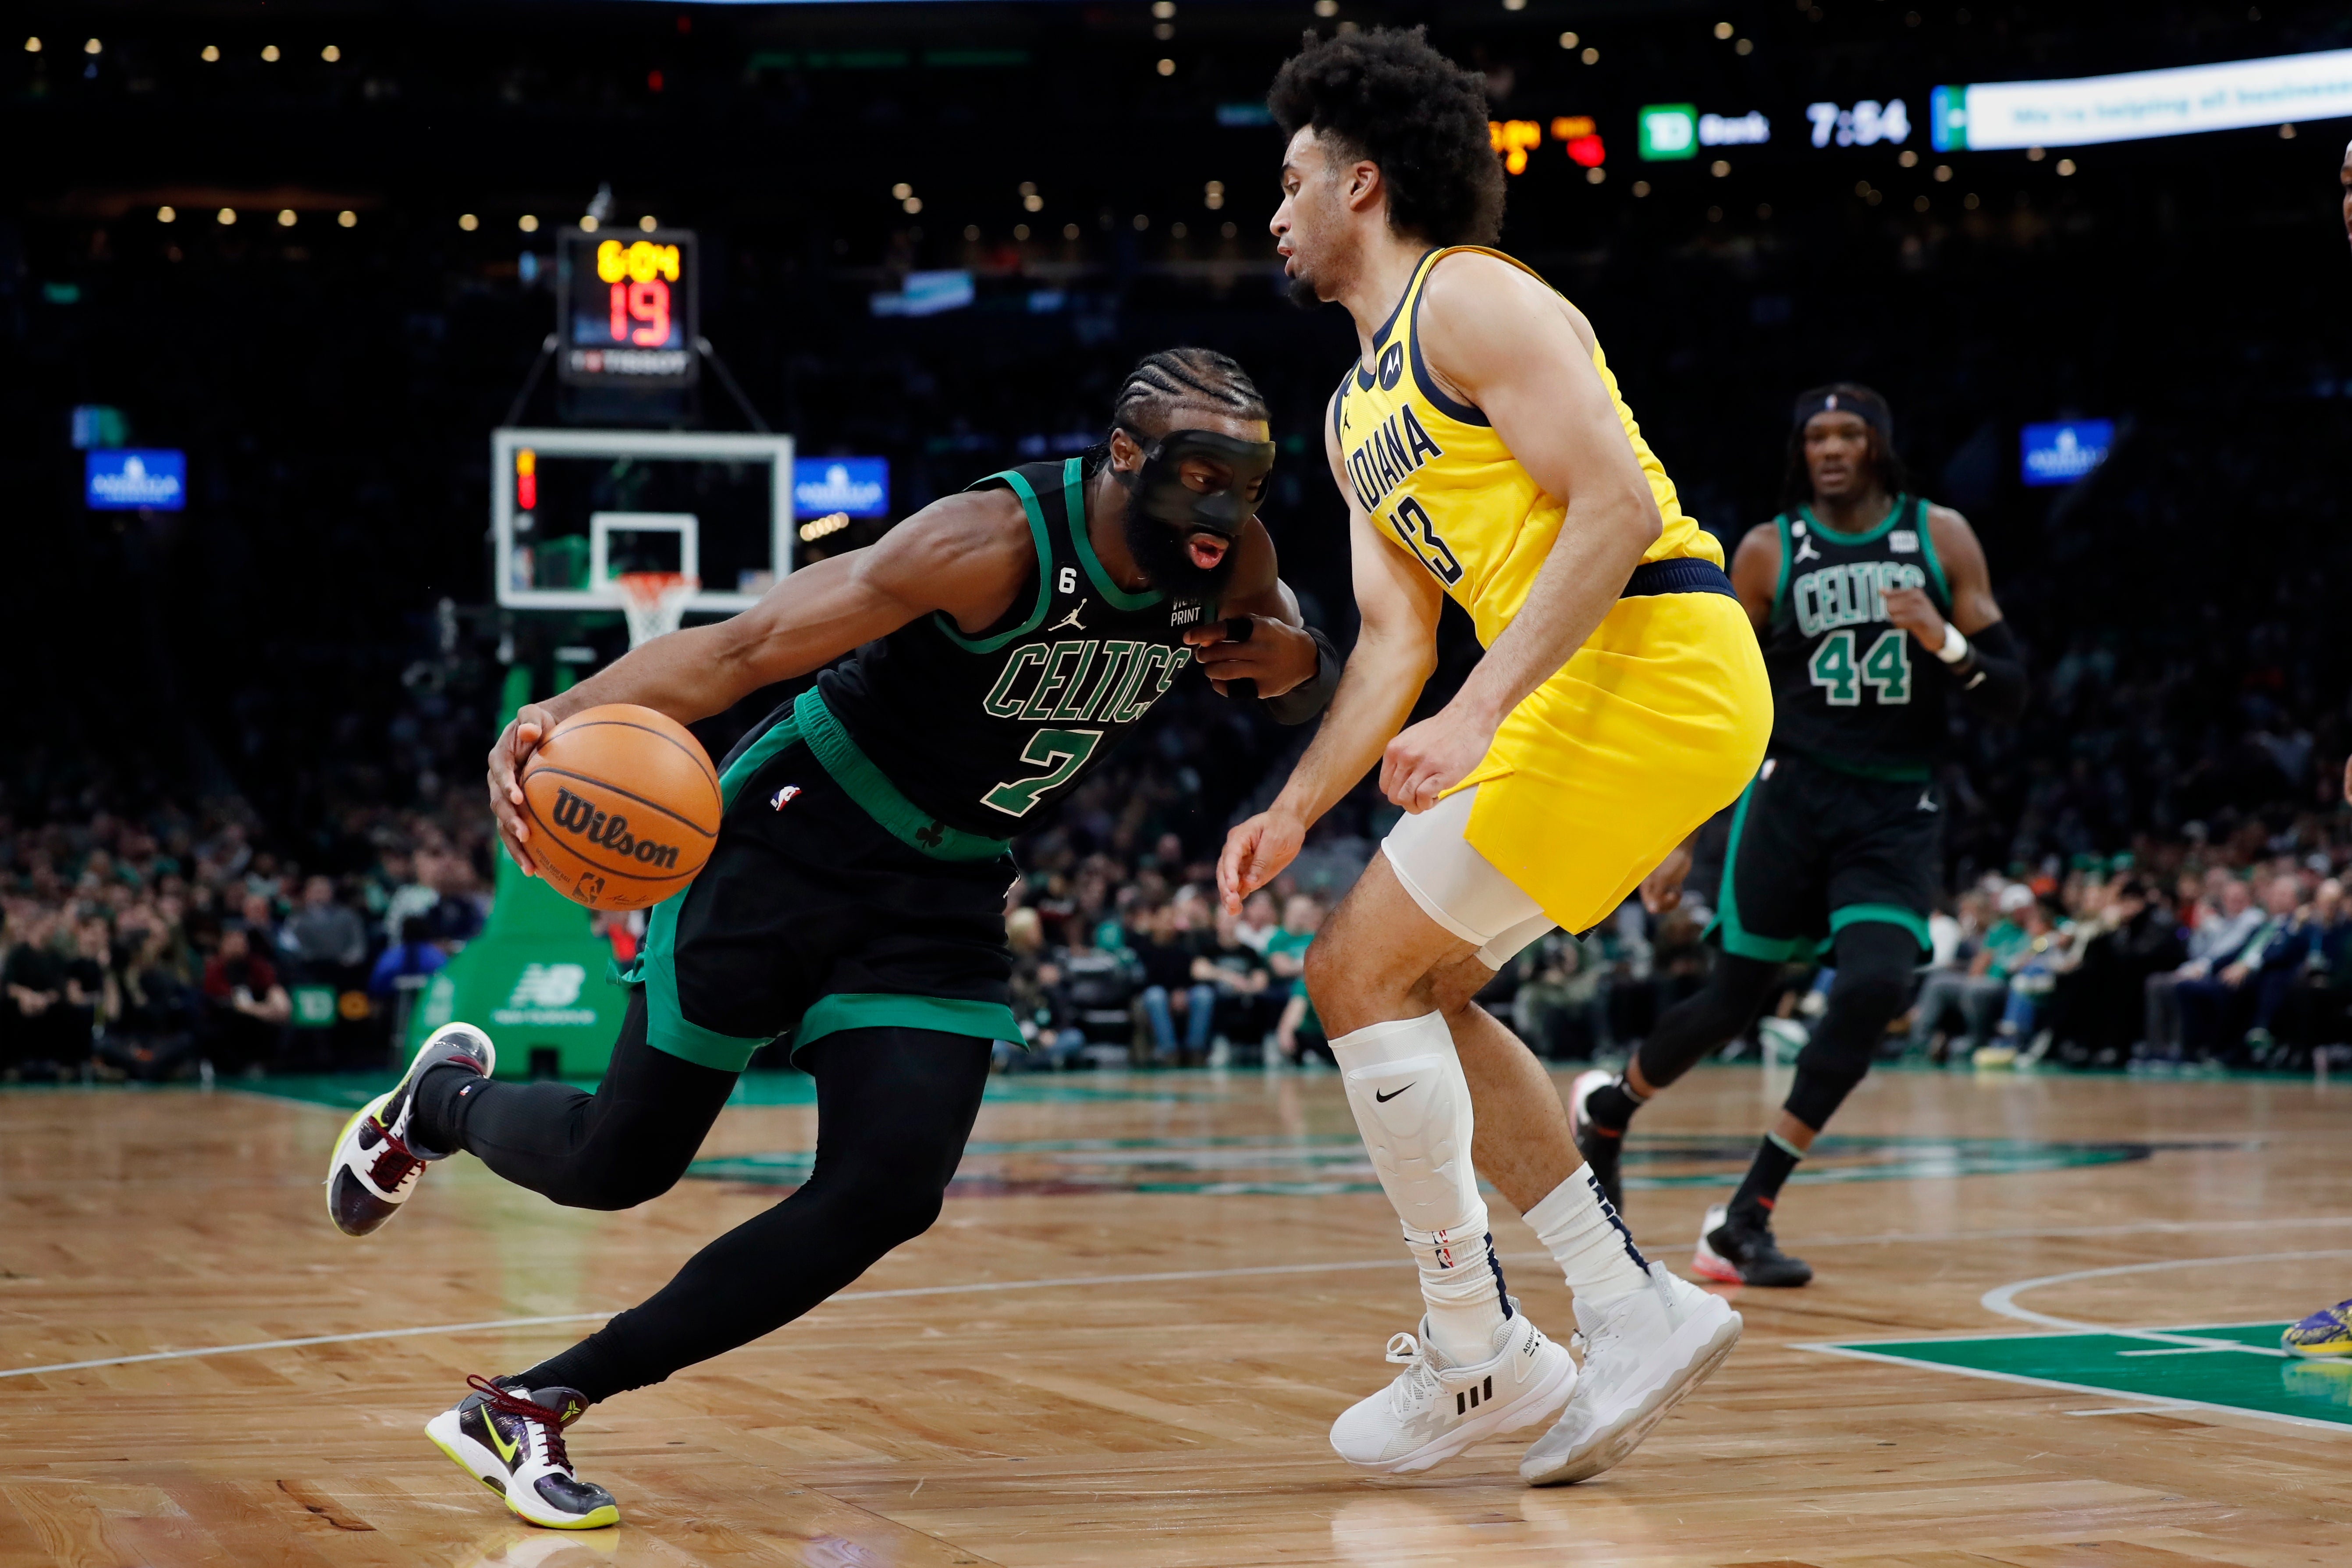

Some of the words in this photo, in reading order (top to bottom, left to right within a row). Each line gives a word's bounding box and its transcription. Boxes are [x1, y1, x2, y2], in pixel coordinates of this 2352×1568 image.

[1645, 112, 1692, 151] TD
[1806, 98, 1911, 149] 7:54
[610, 279, 670, 347] 19
[1387, 494, 1464, 591] 13
[1058, 567, 1077, 594] 6
[1171, 607, 1201, 627] PRINT
[983, 640, 1192, 723] CELTICS
[1808, 629, 1912, 707] 44
[980, 728, 1105, 818] 7
[552, 786, 680, 870] Wilson
[1523, 1331, 1535, 1354] ADMIT
